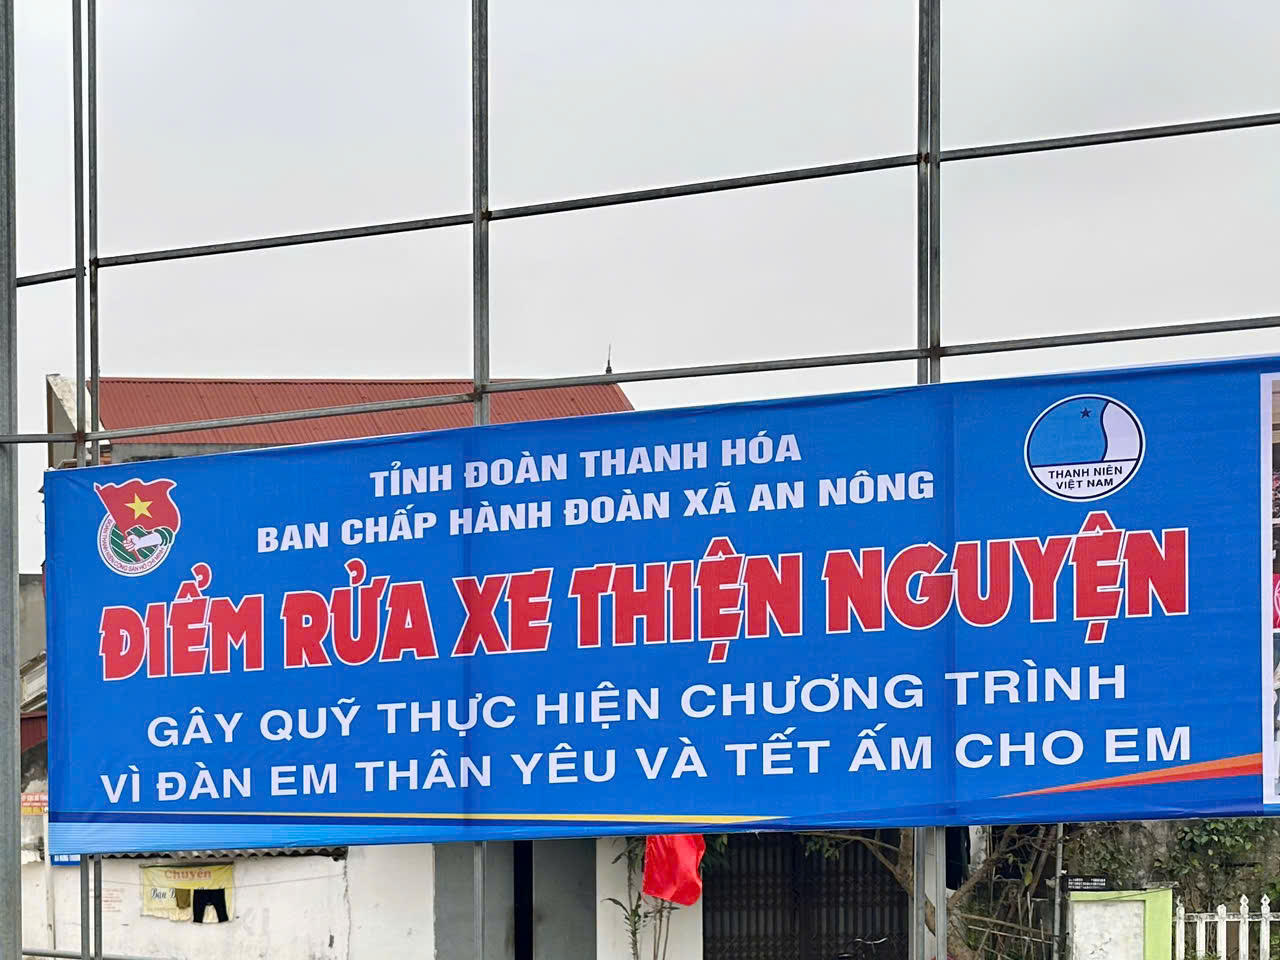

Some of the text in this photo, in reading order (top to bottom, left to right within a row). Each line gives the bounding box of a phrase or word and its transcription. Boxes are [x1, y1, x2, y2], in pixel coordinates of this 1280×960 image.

[370, 431, 801, 497] TỈNH ĐOÀN THANH HÓA
[1048, 468, 1090, 479] THANH
[1056, 478, 1114, 490] VIỆT NAM
[258, 471, 933, 552] BAN CHẤP HÀNH ĐOÀN XÃ AN NÔNG
[99, 511, 1188, 681] ĐIỂM RỬA XE THIỆN NGUYỆN
[148, 660, 1124, 747] GÂY QUỸ THỰC HIỆN CHƯƠNG TRÌNH
[101, 723, 1192, 803] VÌ ĐÀN EM THÂN YÊU VÀ TẾT ẤM CHO EM
